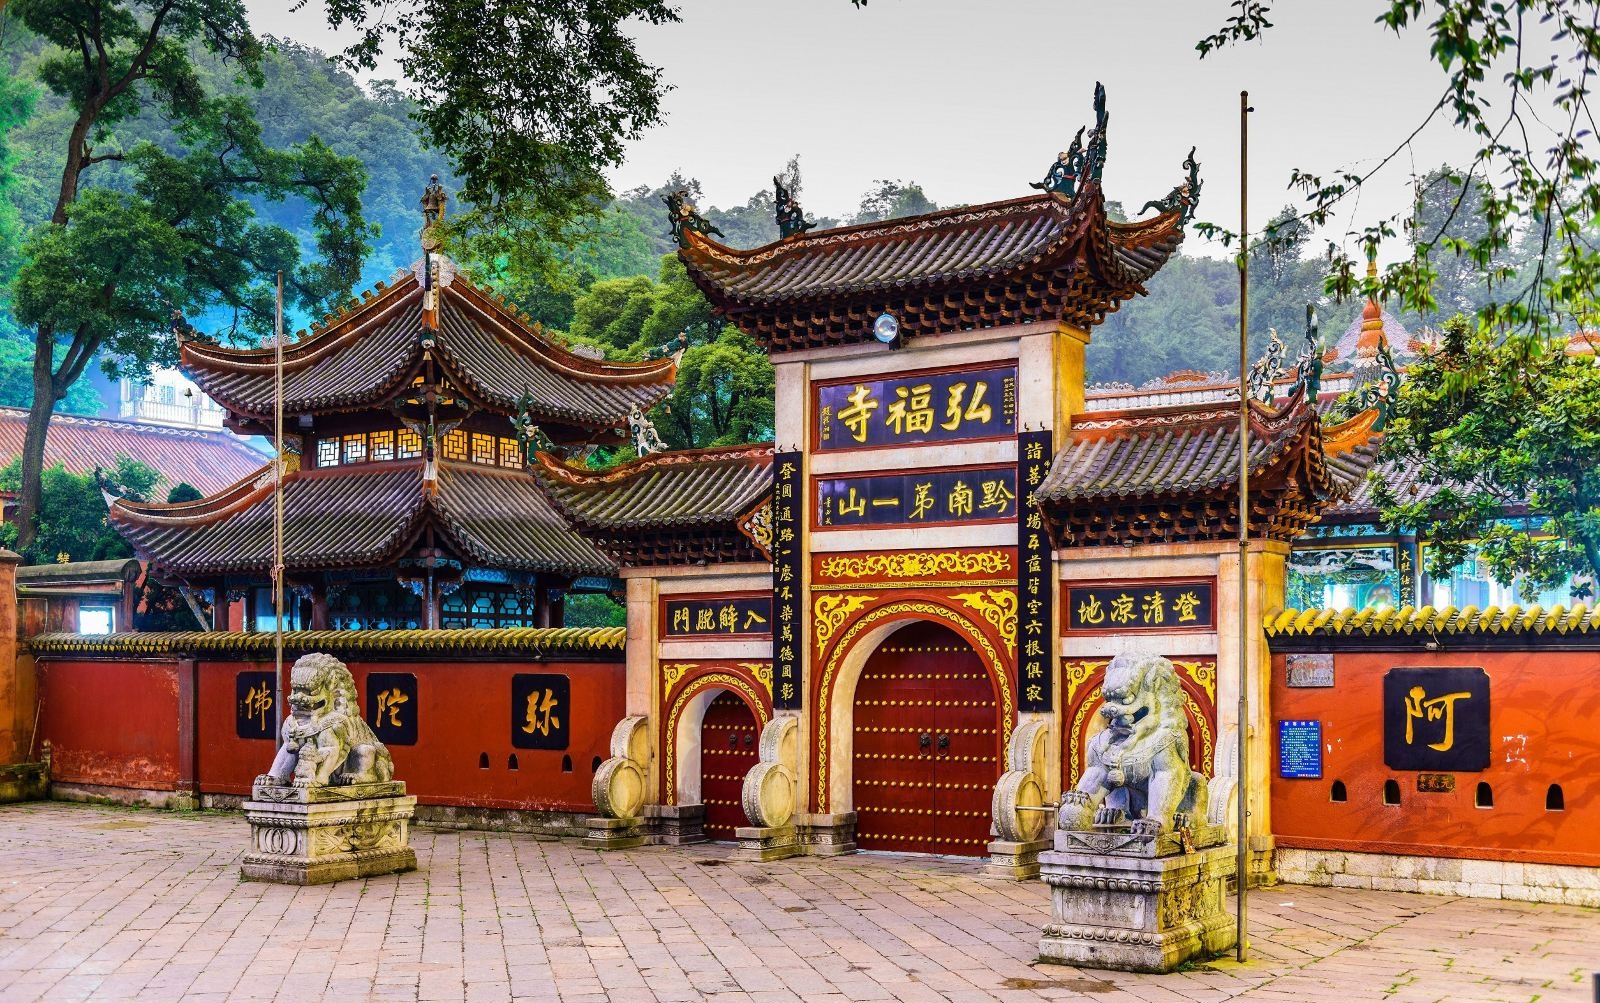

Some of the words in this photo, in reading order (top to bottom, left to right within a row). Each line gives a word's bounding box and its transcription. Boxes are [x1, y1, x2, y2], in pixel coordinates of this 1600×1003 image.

[838, 382, 992, 442] 弘福寺
[245, 680, 272, 731] 佛
[1404, 685, 1472, 752] 阿
